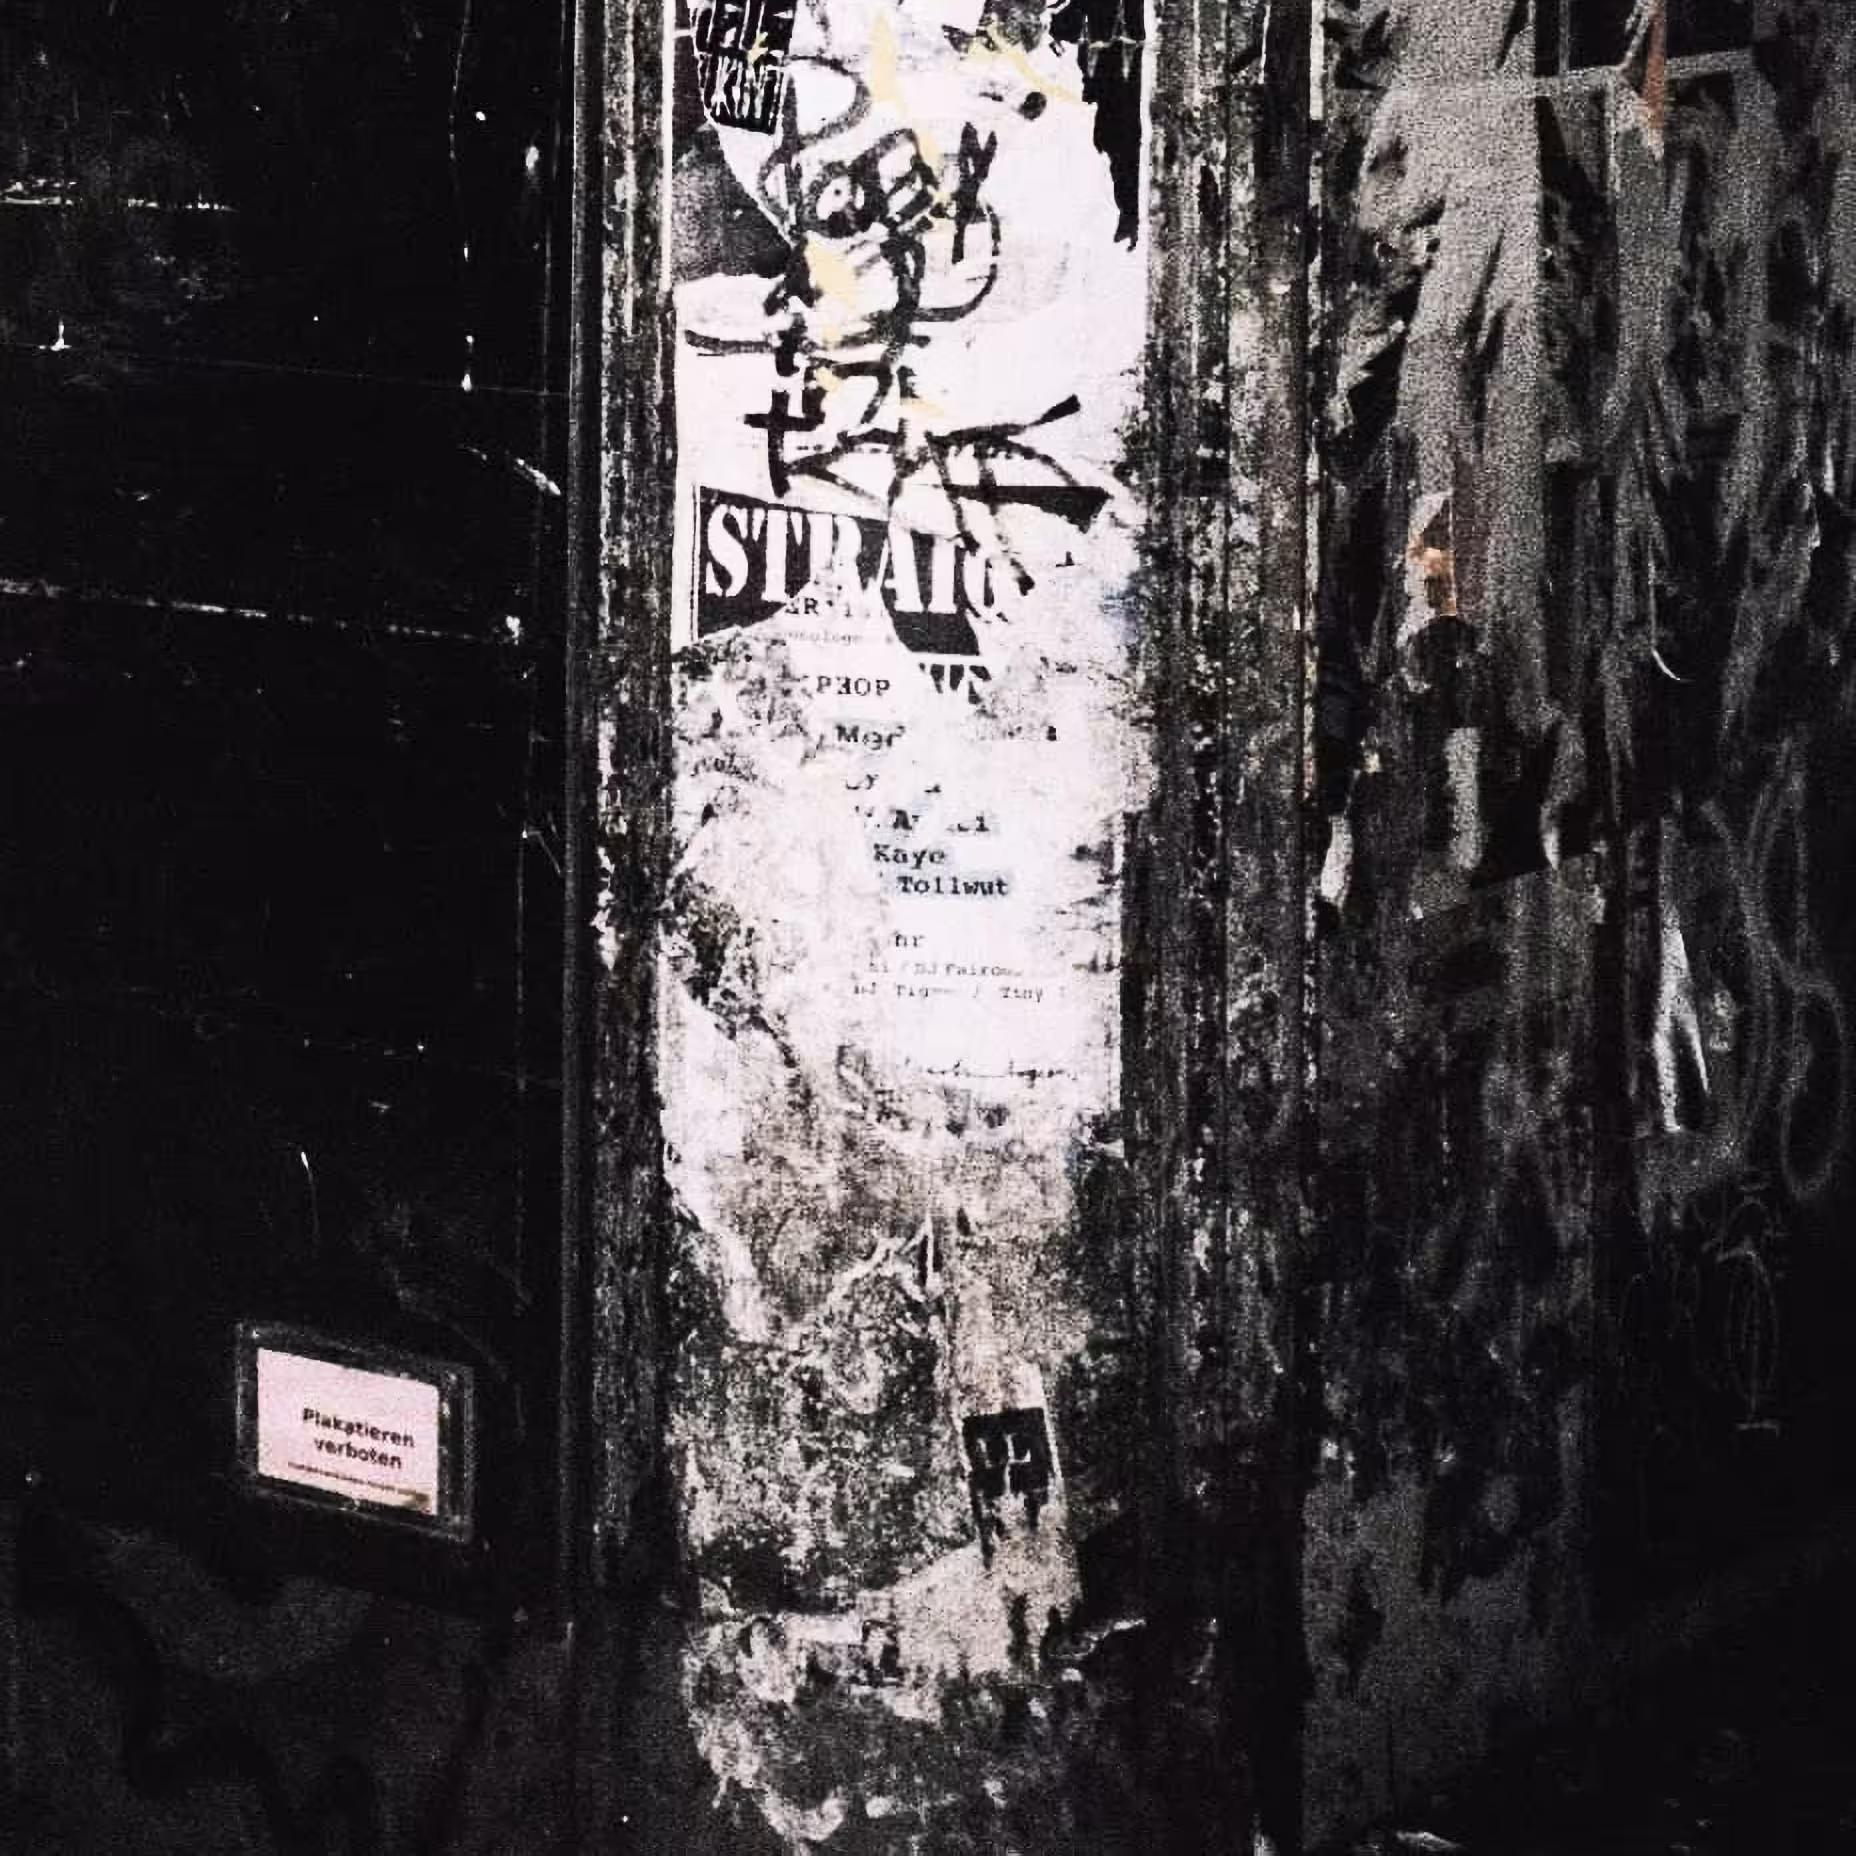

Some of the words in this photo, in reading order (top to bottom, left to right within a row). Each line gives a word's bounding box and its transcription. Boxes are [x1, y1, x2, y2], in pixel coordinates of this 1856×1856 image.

[896, 875, 1009, 896] Tollwut
[303, 1407, 416, 1449] Plakatieren
[314, 1437, 402, 1470] verboten
